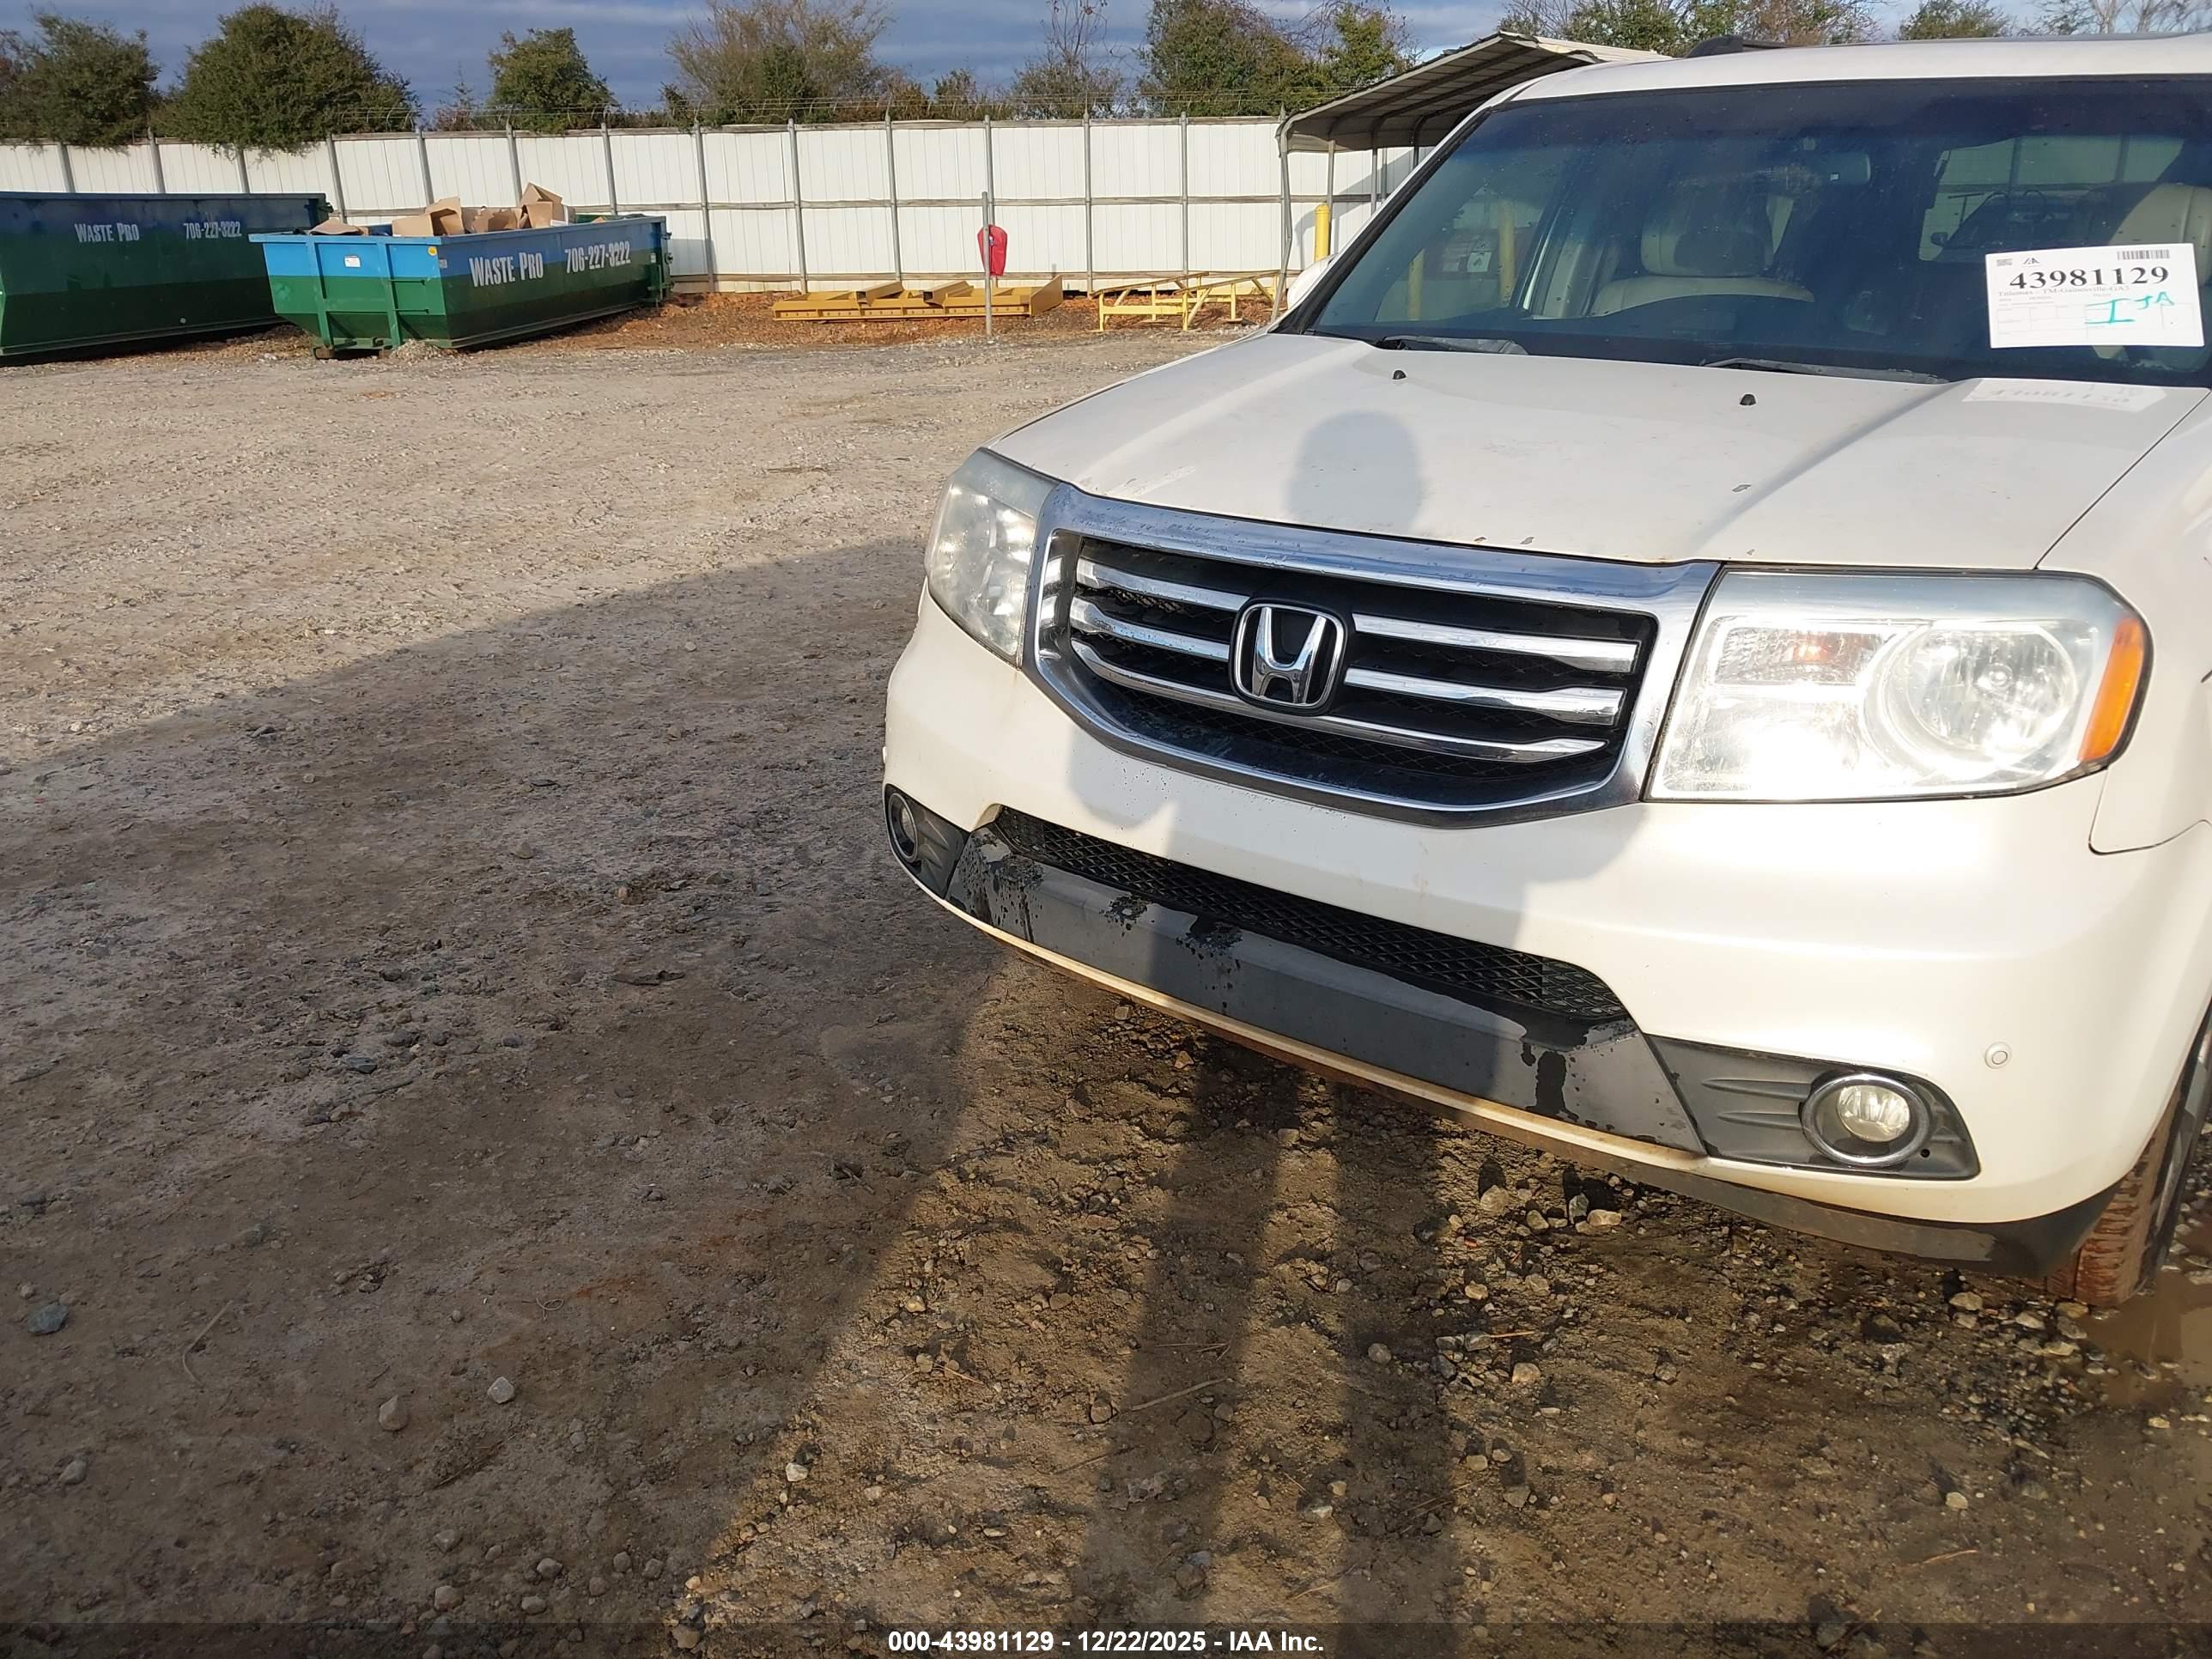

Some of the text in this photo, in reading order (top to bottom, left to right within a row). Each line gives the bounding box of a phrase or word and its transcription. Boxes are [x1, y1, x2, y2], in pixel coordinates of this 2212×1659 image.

[75, 223, 114, 242] WASTE
[117, 222, 140, 242] PRO
[469, 240, 632, 287] WASTE PRO 706-227-3222
[2009, 266, 2169, 289] 43981129
